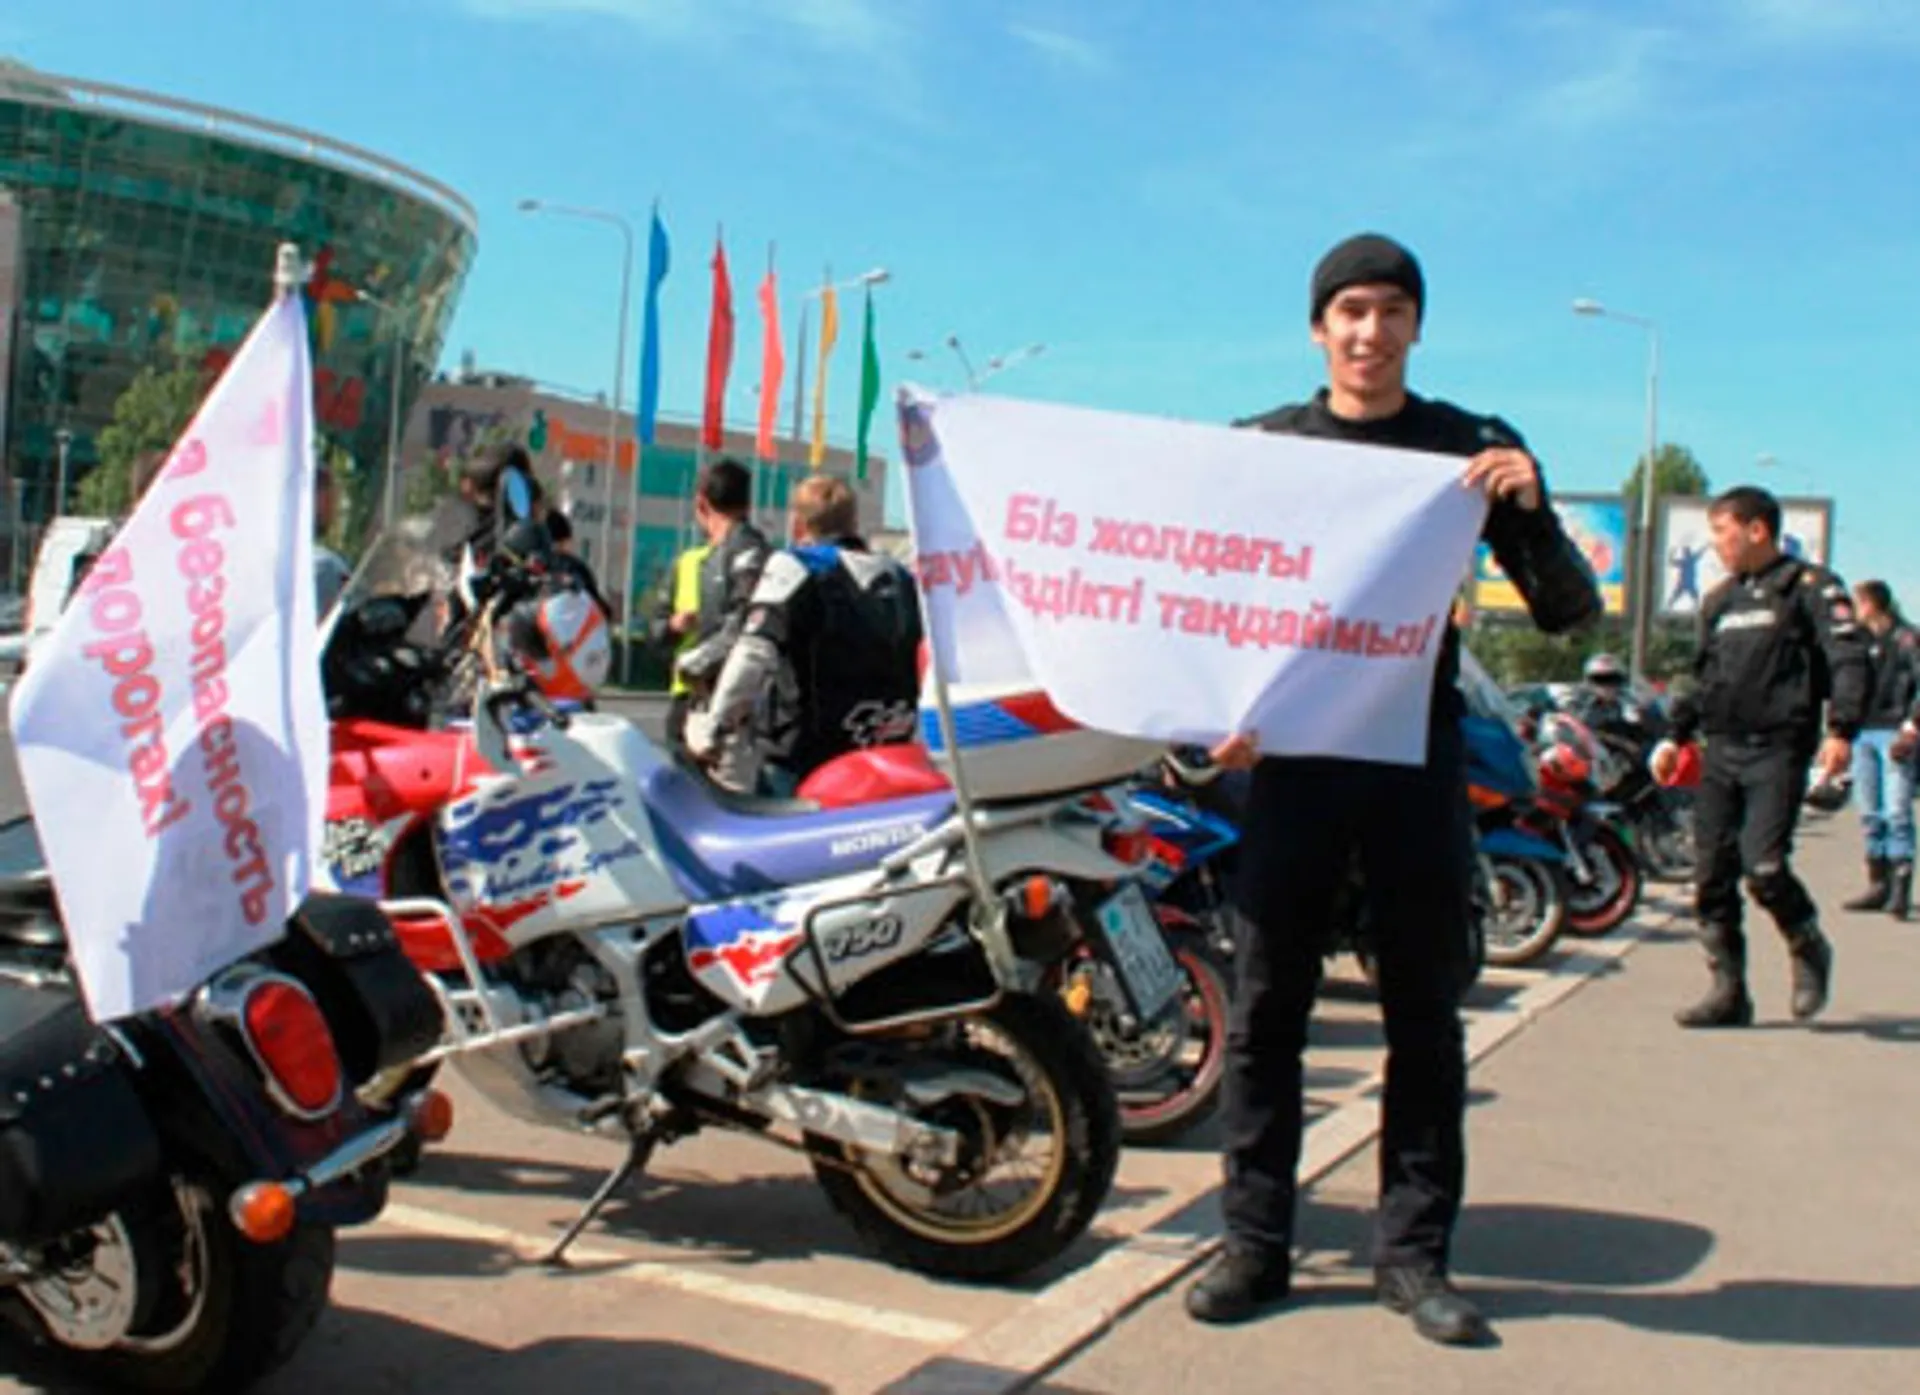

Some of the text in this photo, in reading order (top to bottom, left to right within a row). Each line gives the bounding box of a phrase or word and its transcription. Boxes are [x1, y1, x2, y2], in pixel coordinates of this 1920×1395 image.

[1003, 492, 1314, 582] Біз жолдағы
[169, 494, 276, 926] безопасность
[824, 914, 903, 965] 750
